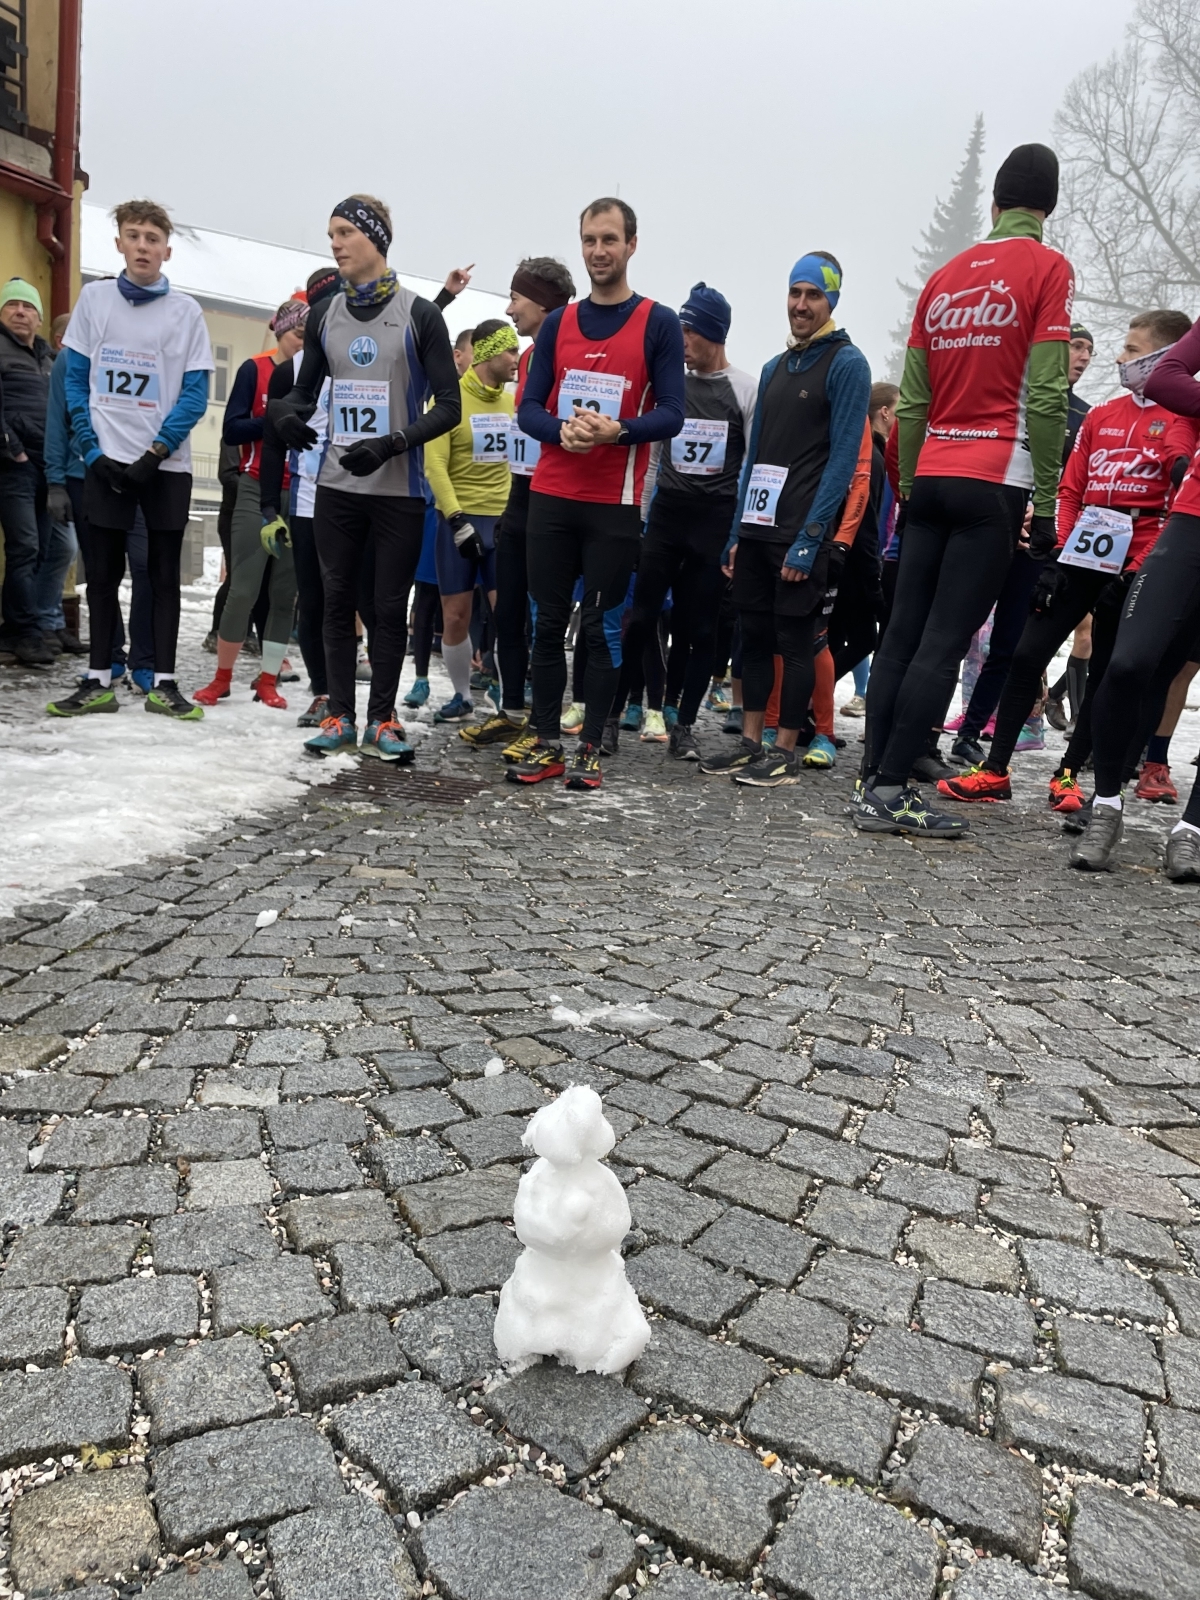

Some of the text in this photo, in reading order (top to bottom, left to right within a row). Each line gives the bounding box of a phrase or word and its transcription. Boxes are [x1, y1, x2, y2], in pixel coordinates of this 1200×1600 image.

[925, 285, 1018, 334] Carla
[931, 332, 1001, 350] Chocolates
[105, 370, 150, 397] 127
[600, 388, 620, 396] LIGA
[340, 406, 377, 433] 112
[483, 433, 507, 452] 25
[683, 441, 713, 464] 37
[1088, 448, 1162, 479] Carla
[1086, 480, 1149, 493] Chocolates
[748, 488, 770, 512] 118
[1073, 530, 1114, 558] 50
